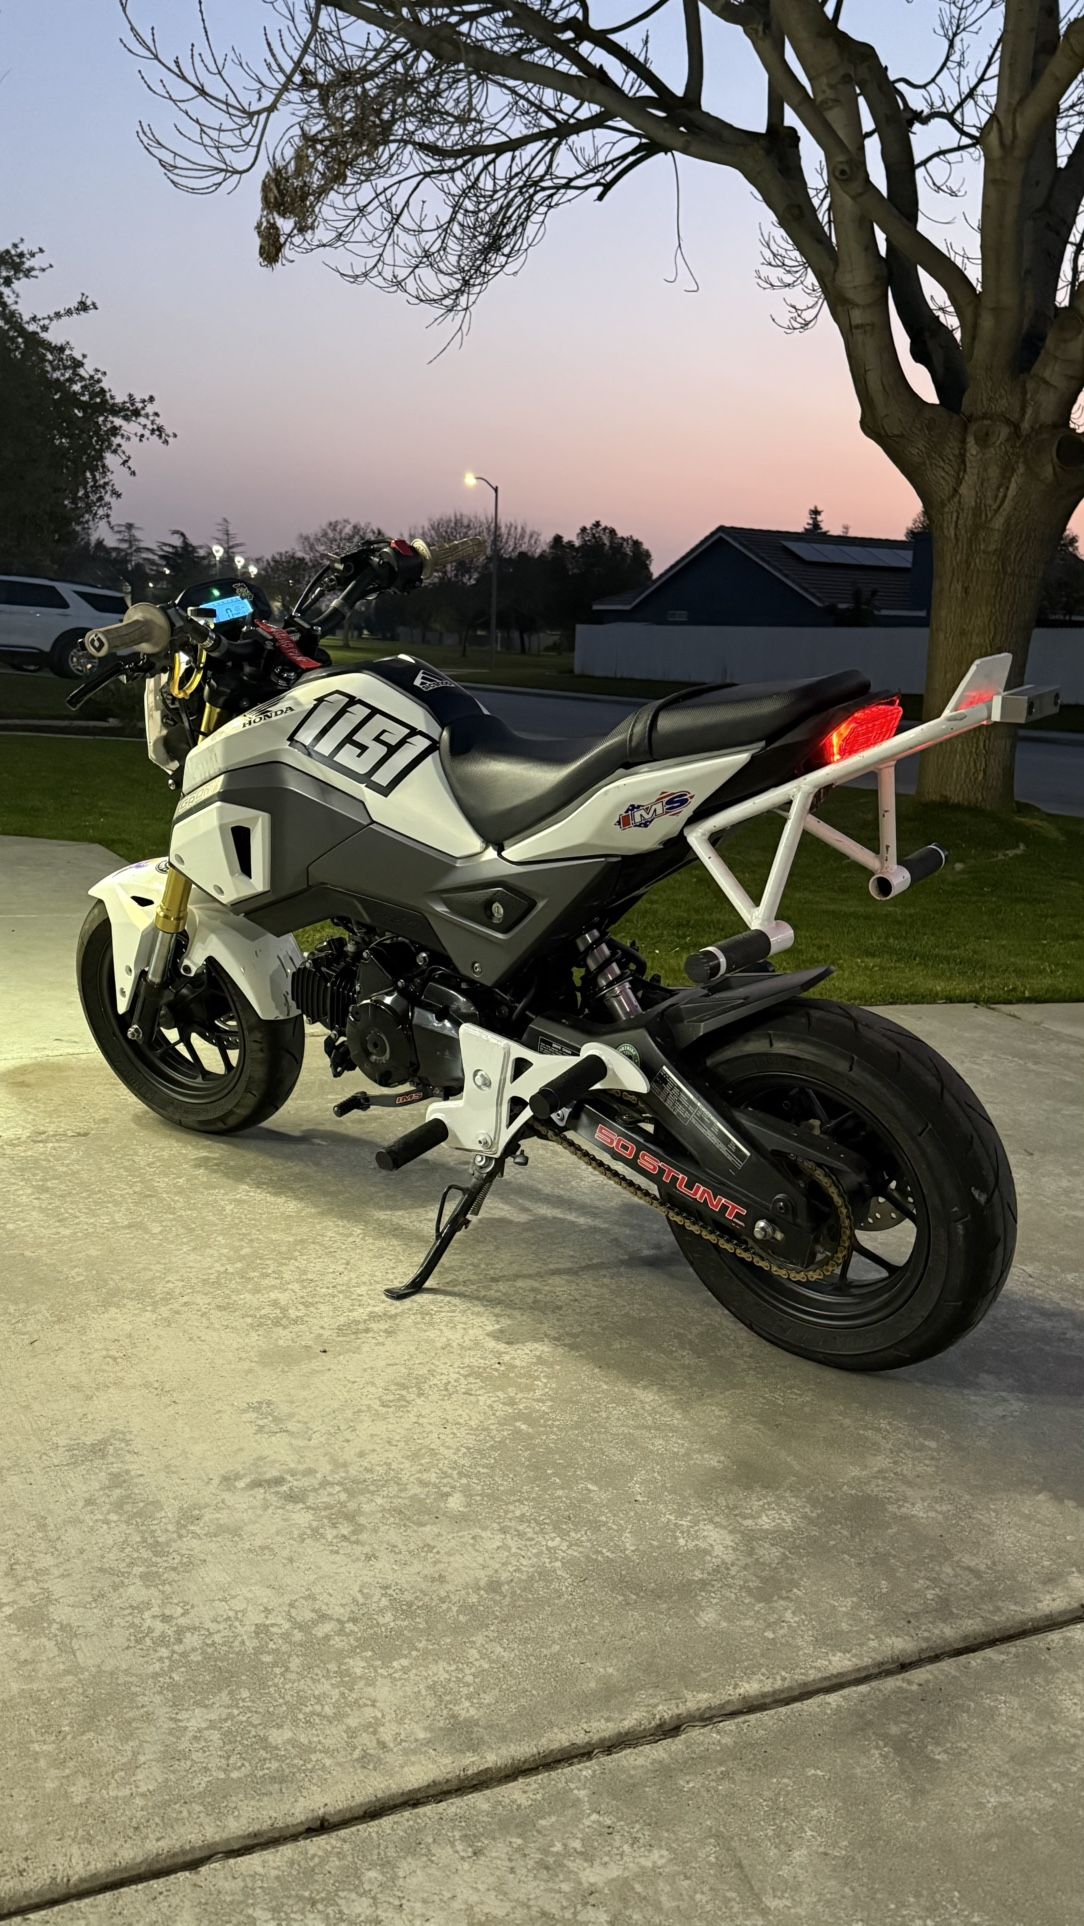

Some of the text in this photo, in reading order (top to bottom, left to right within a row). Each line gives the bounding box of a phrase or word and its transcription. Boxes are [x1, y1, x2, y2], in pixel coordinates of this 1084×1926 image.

[242, 706, 295, 728] HONDA
[288, 690, 440, 797] 1151
[637, 1151, 747, 1220] STUNT
